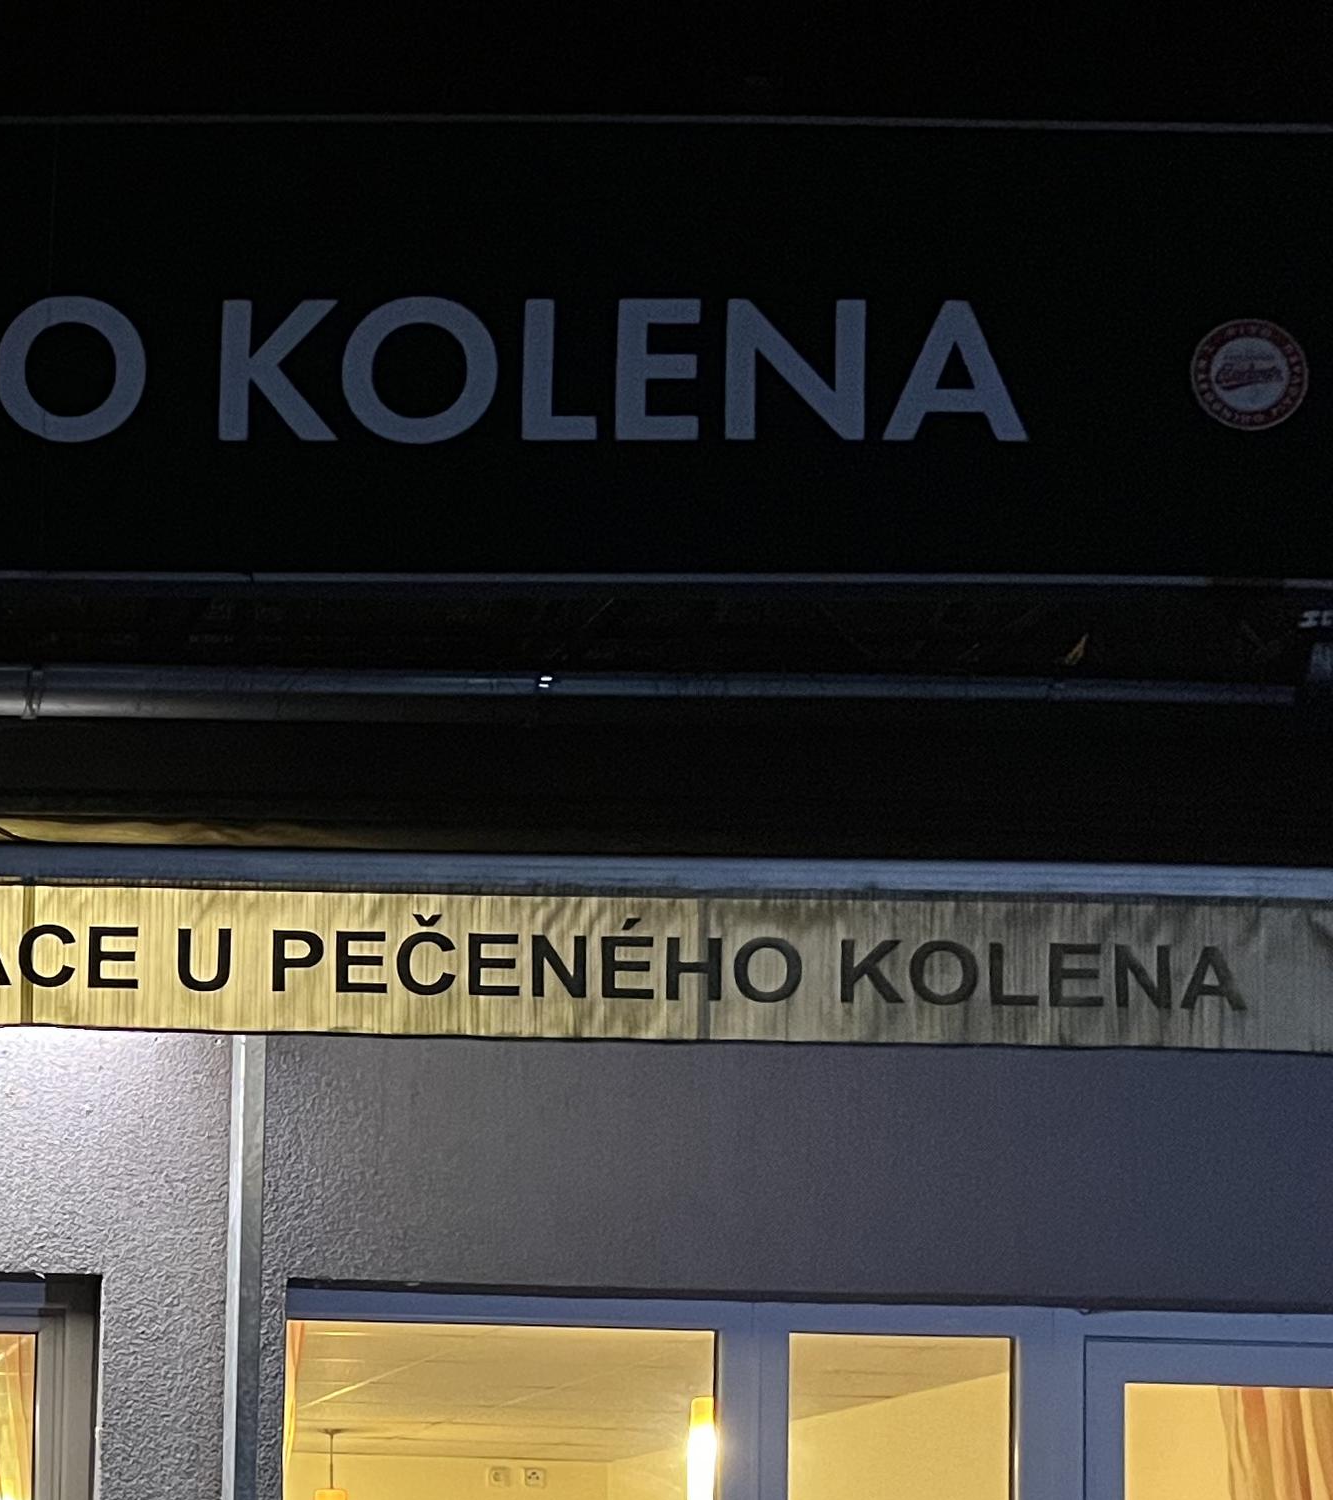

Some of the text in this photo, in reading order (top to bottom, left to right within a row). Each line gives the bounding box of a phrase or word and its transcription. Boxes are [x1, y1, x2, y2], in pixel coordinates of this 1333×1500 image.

[216, 294, 1030, 446] KOLENA
[176, 927, 235, 993] U
[269, 913, 806, 1004] PEČENÉHO
[839, 939, 1250, 1012] KOLENA
